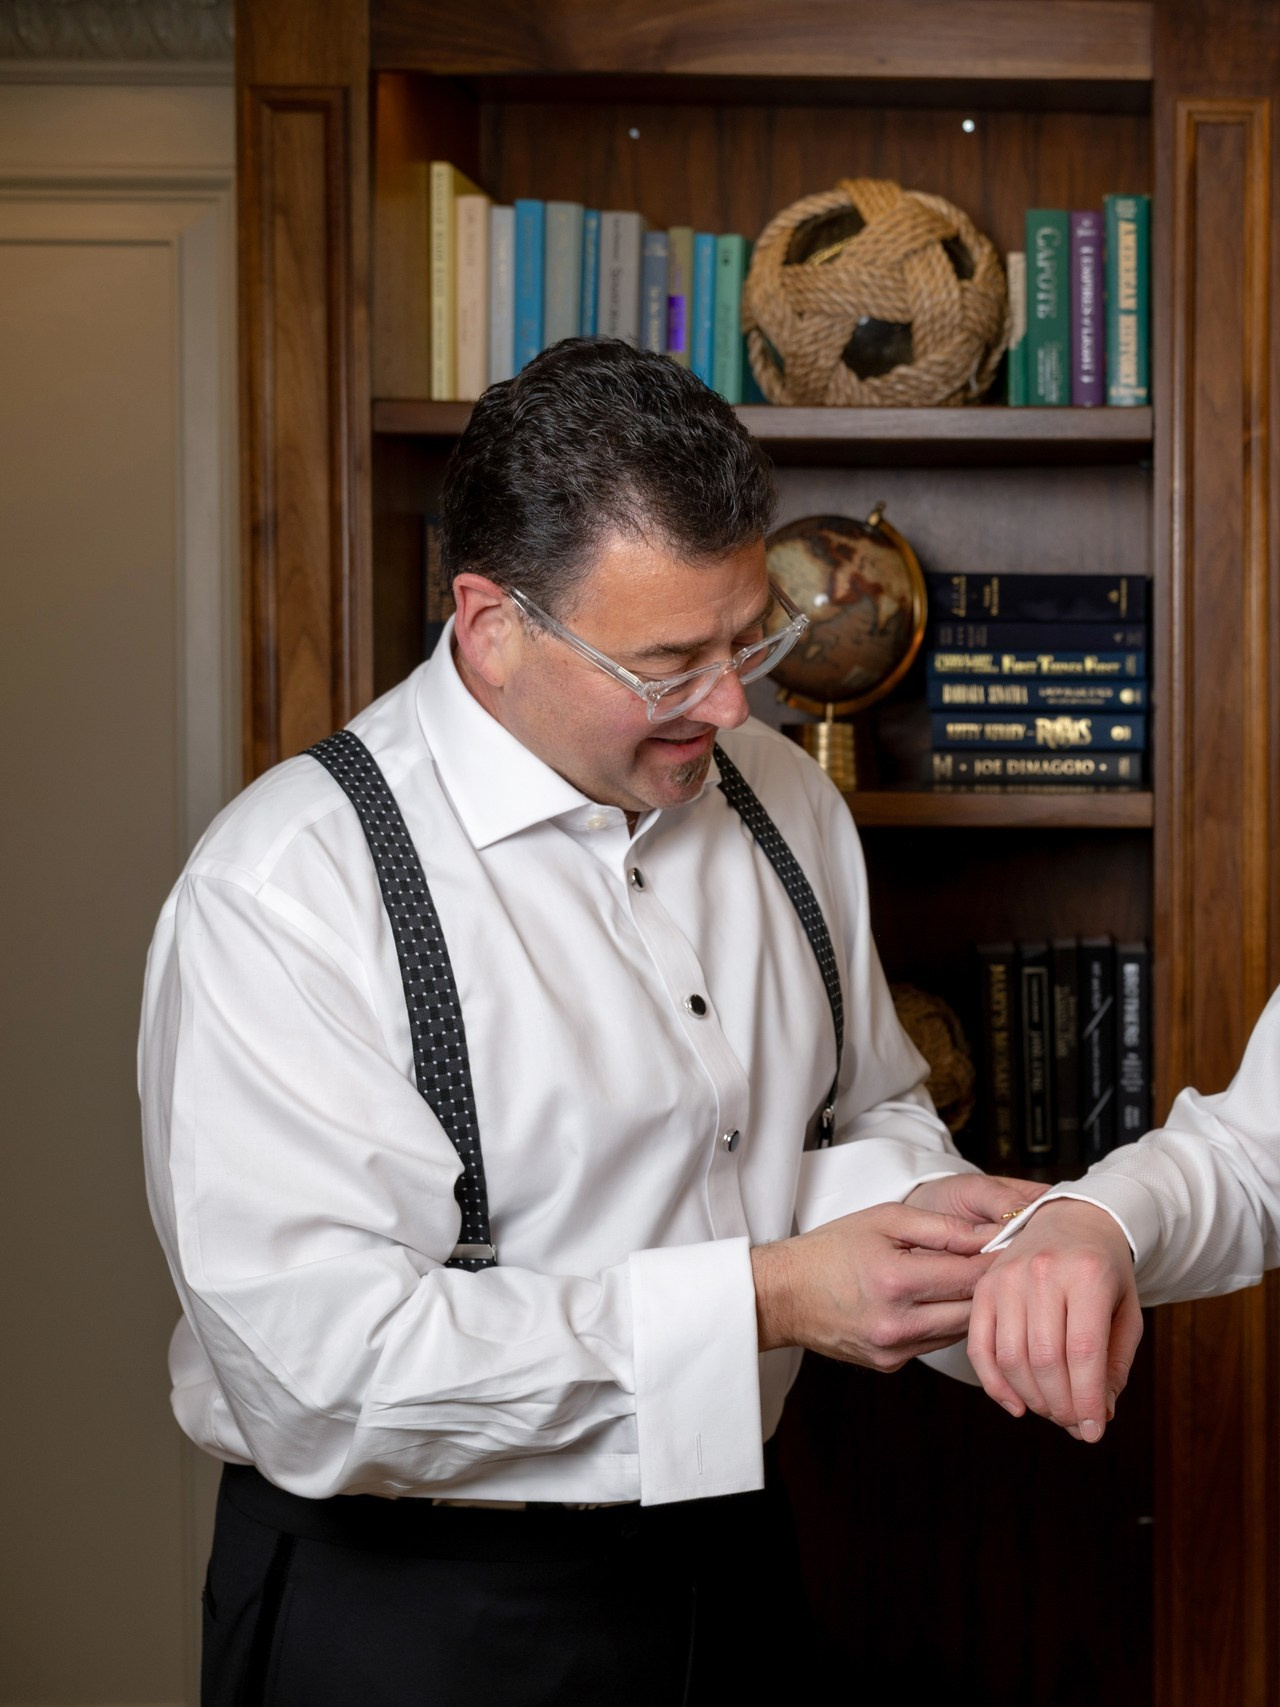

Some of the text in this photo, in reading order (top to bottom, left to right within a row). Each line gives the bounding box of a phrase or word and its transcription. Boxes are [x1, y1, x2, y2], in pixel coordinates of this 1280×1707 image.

[1036, 226, 1061, 319] CAPOTE
[974, 759, 1096, 776] JOE DIMAGGIO
